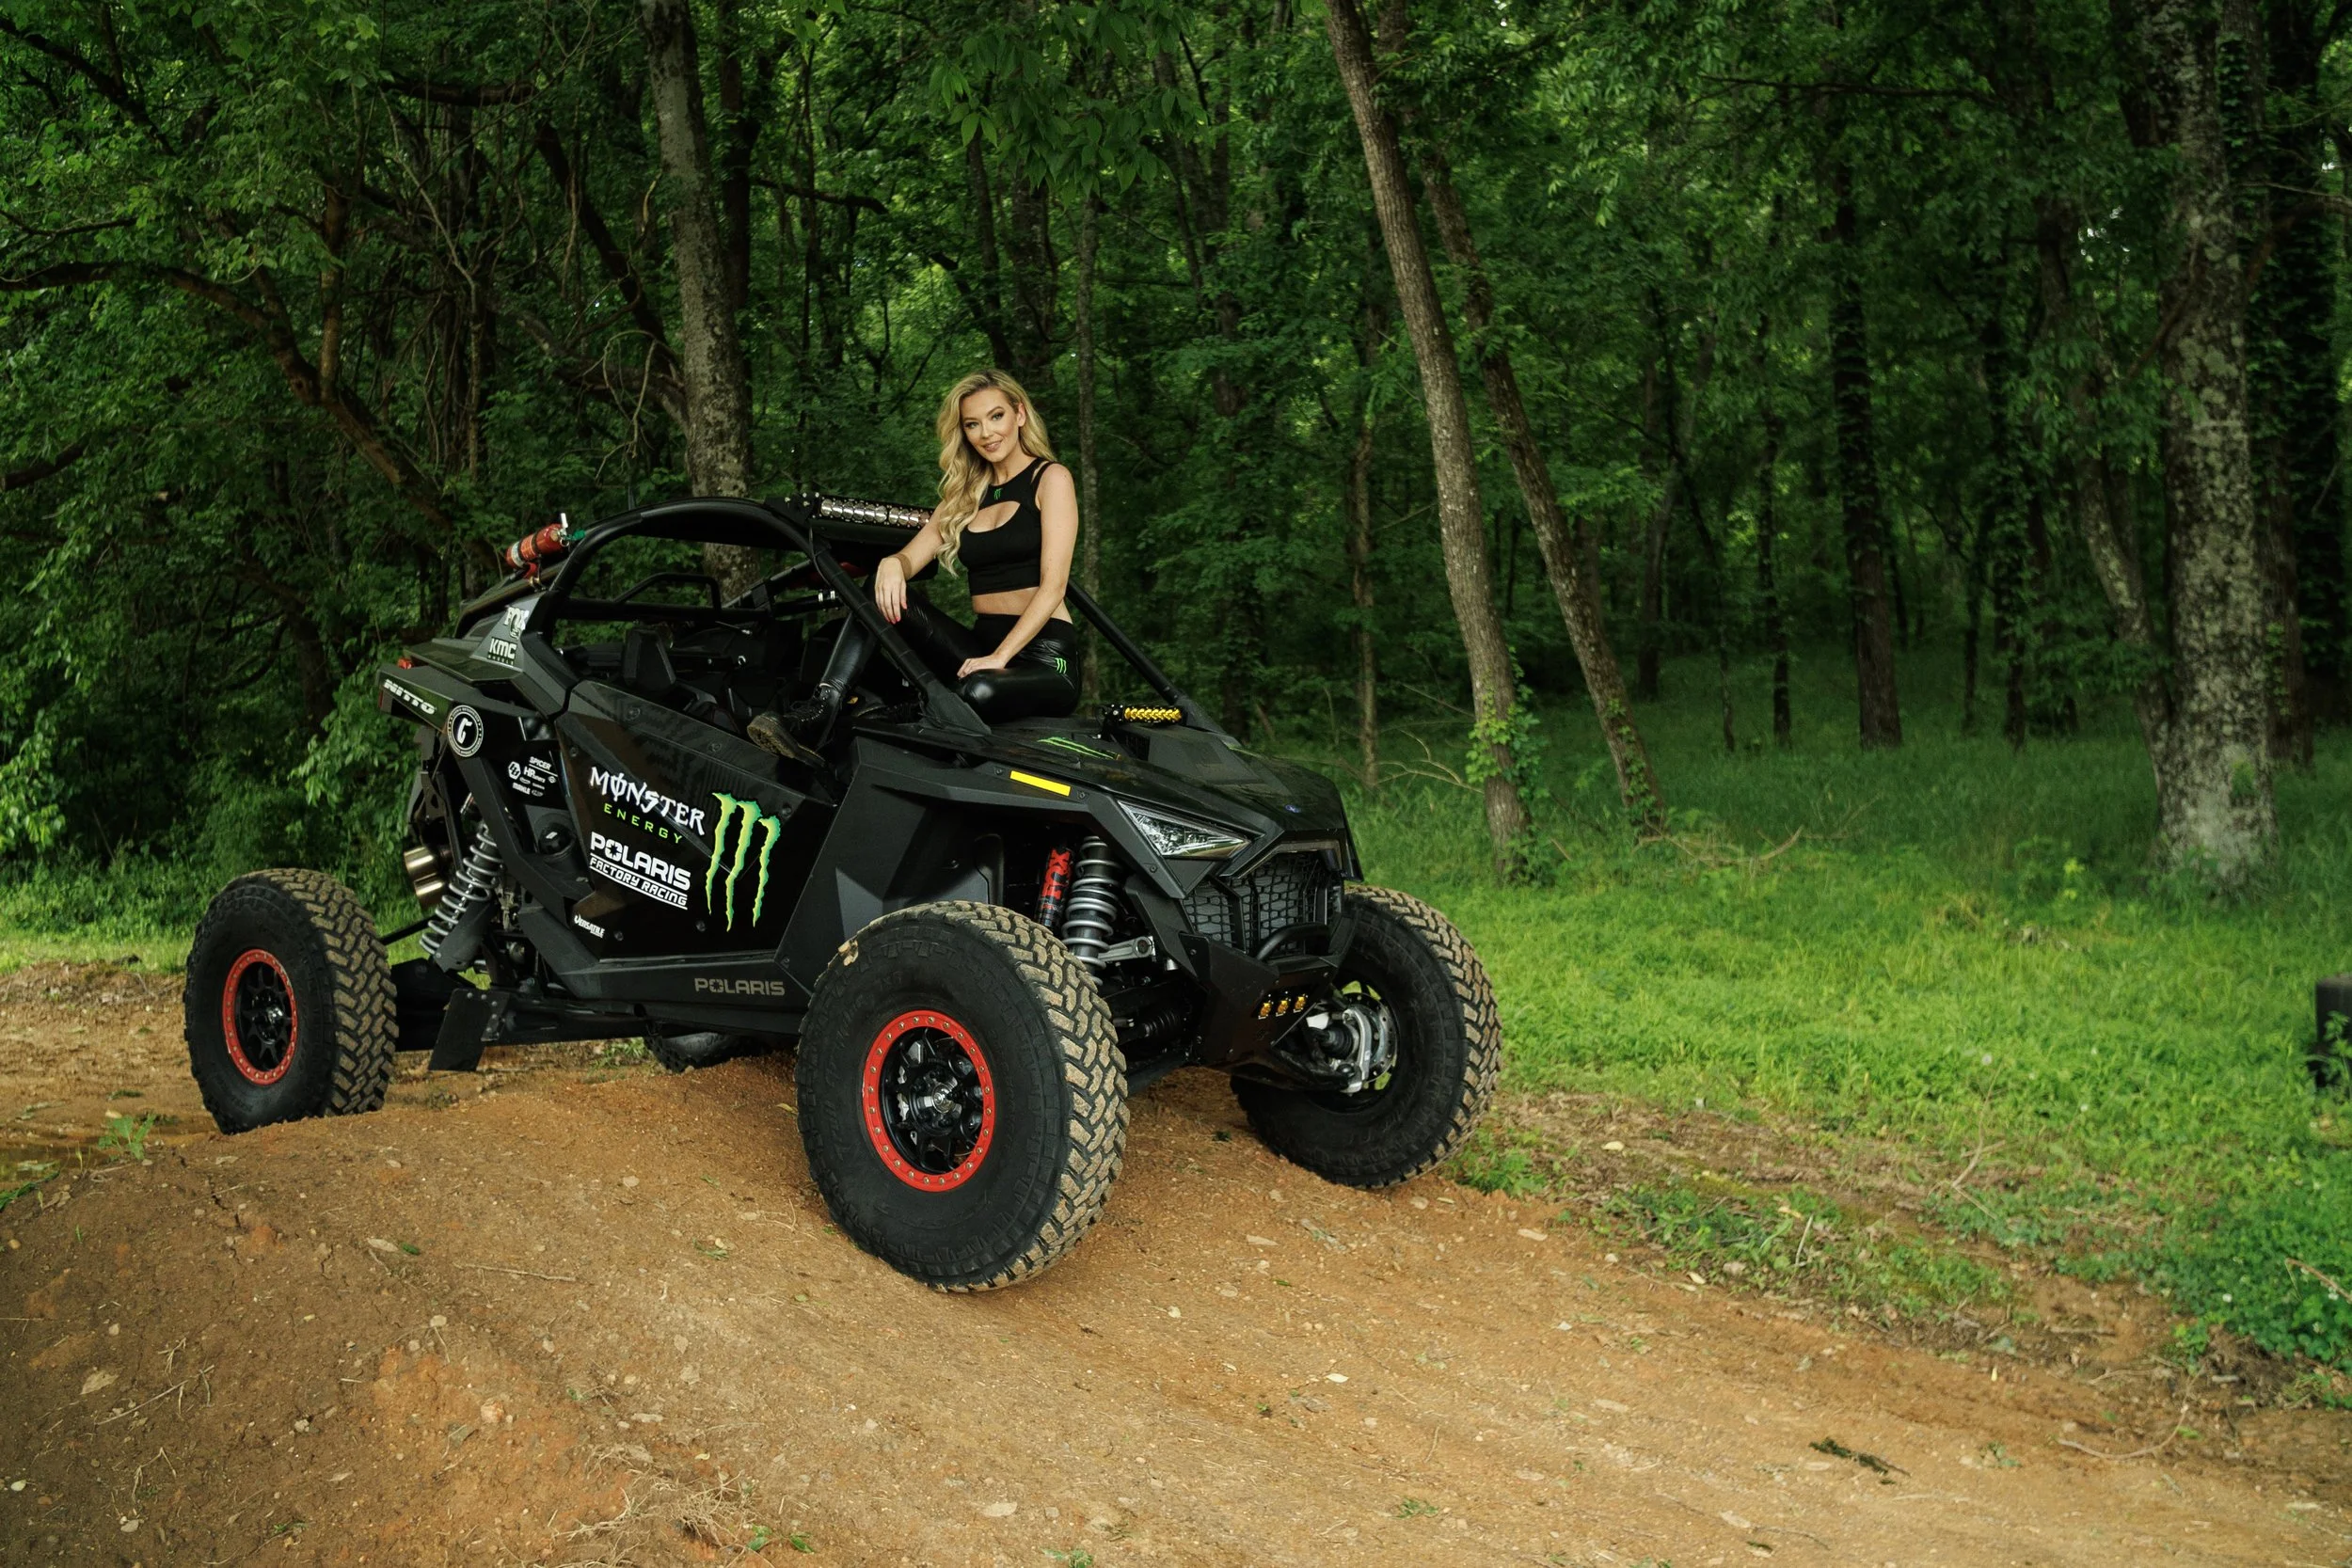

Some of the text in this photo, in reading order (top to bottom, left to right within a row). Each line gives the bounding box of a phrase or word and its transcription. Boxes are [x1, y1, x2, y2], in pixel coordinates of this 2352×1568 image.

[489, 638, 516, 659] KMC
[384, 678, 436, 715] NITTO
[529, 756, 551, 770] SPICER
[603, 802, 683, 844] ENERGY
[590, 831, 691, 891] POLARIS
[1041, 848, 1071, 901] FOX
[589, 856, 689, 906] FACTORY RACING
[574, 913, 606, 939] VERSATILE
[694, 977, 786, 996] POLARIS
